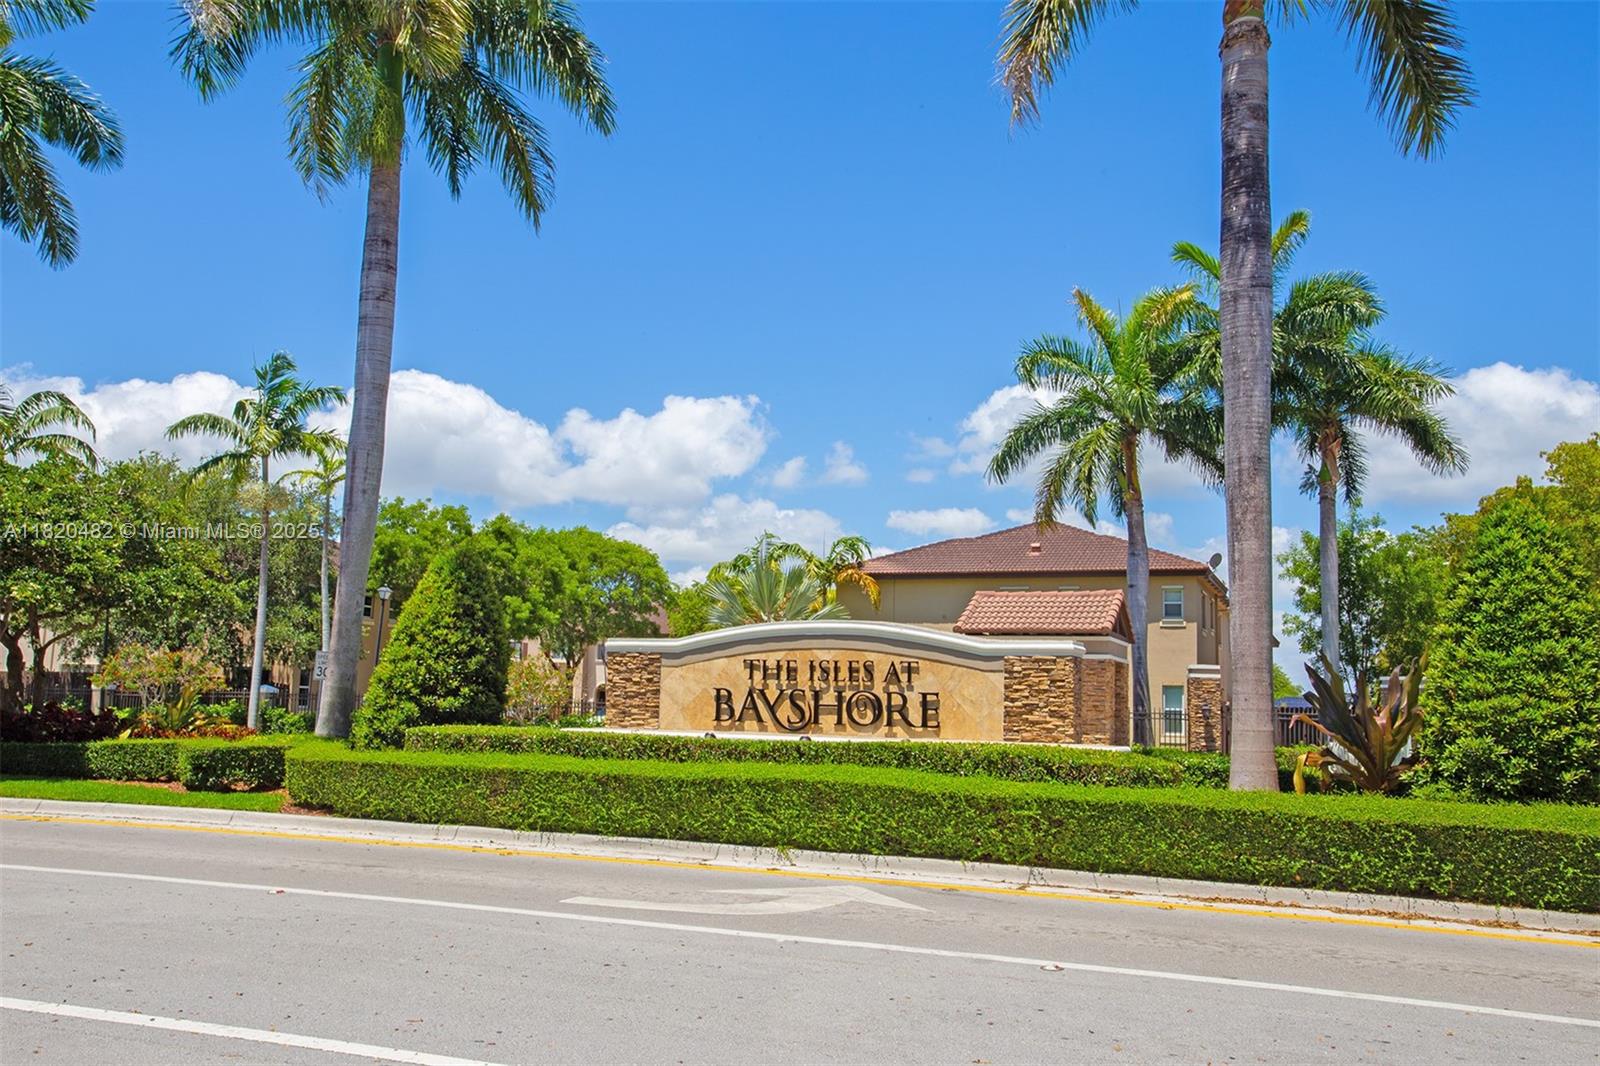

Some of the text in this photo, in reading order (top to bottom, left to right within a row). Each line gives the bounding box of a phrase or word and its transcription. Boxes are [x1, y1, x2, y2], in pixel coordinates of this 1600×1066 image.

[743, 659, 920, 684] THE ISLES AT
[712, 687, 940, 731] BAYSHORE
